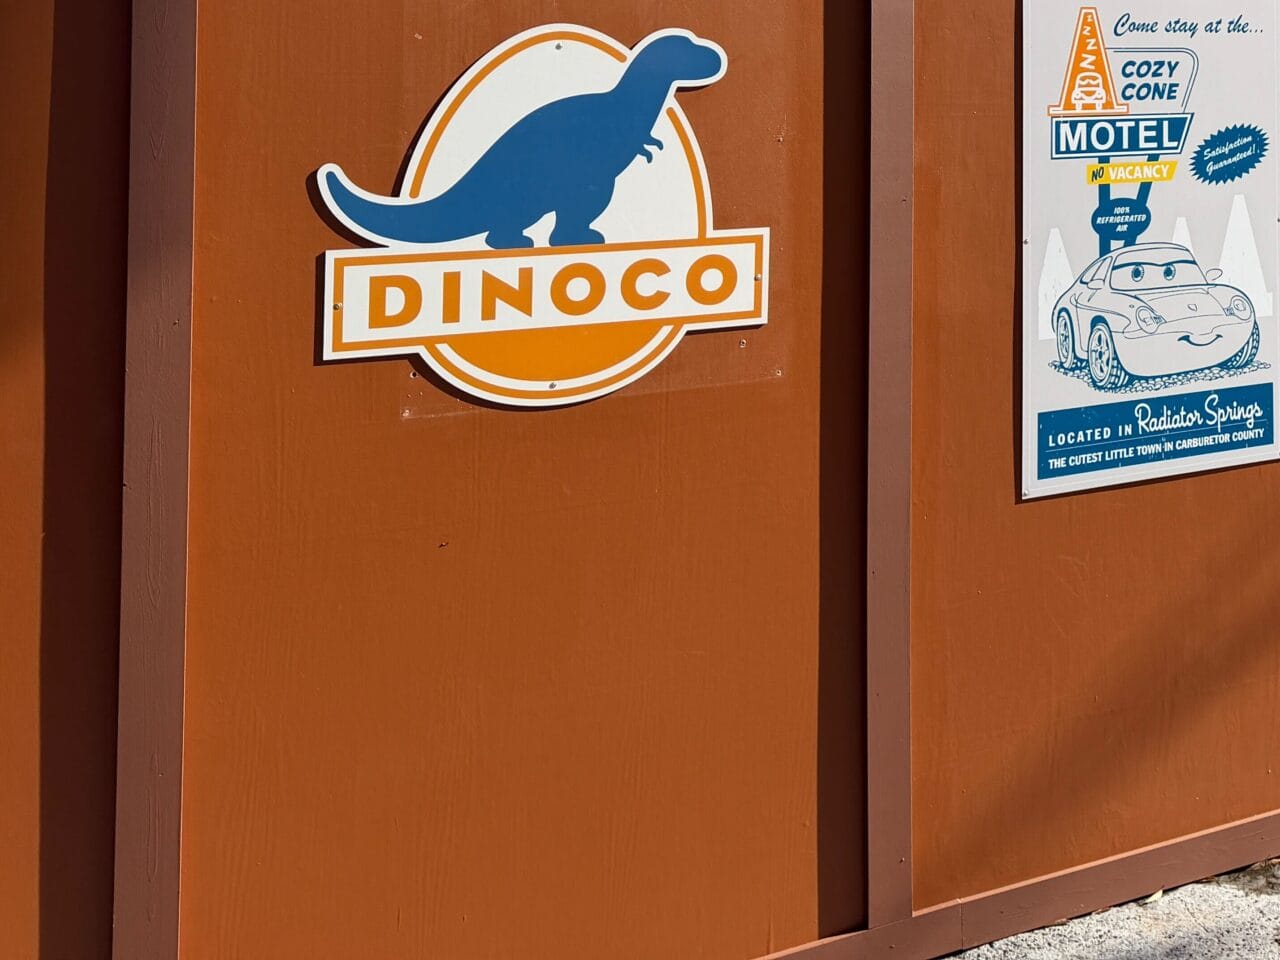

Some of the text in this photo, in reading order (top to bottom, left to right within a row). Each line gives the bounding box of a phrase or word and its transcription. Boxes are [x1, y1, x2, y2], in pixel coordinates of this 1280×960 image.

[1113, 12, 1159, 37] Come
[1164, 17, 1200, 38] stay
[1204, 18, 1222, 34] at
[1120, 60, 1180, 79] COZY
[1120, 82, 1180, 101] CONE
[1059, 119, 1179, 152] MOTEL
[1204, 136, 1252, 160] Satisfaction
[1206, 144, 1256, 176] Guaranteed!
[1092, 164, 1170, 182] NO VACANCY
[1096, 214, 1146, 224] REFRIGERATED
[1114, 206, 1130, 214] 100%
[368, 254, 738, 330] DINOCO
[1048, 394, 1263, 446] LOCATED IN Radiator Springs
[1048, 428, 1265, 470] THE CUTEST LITTLE TOWN IN CARBURETOR COUNTY
